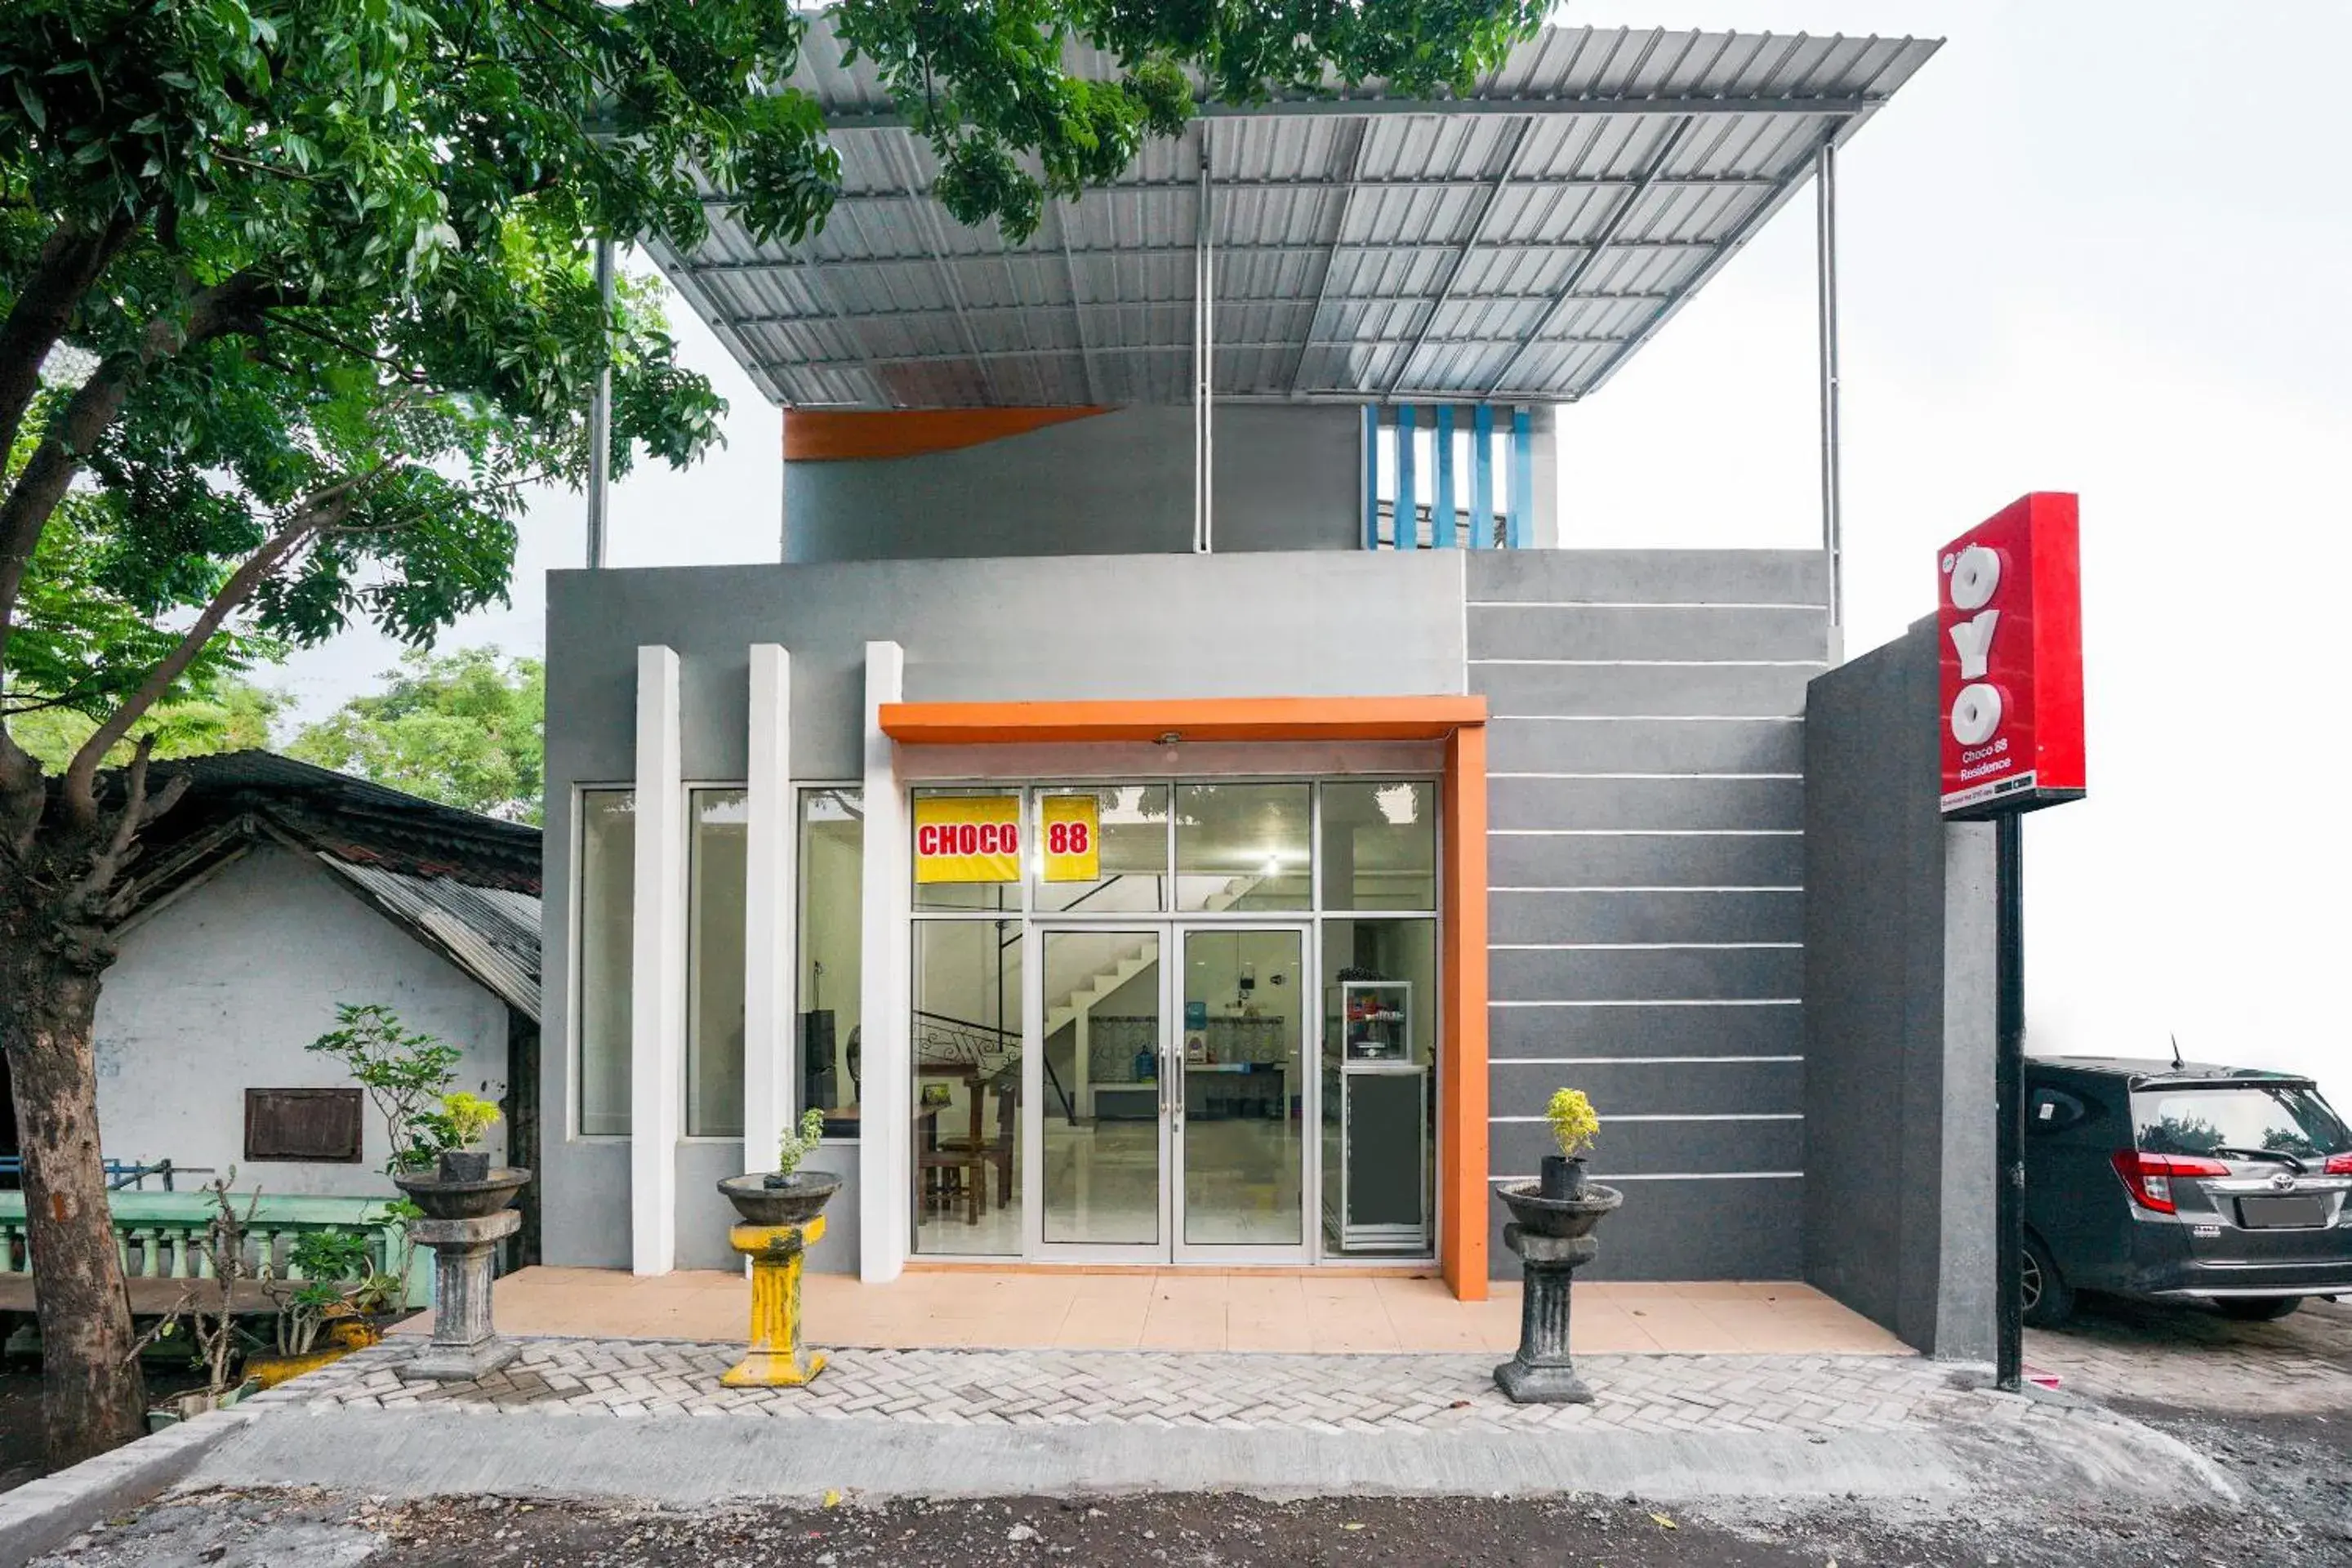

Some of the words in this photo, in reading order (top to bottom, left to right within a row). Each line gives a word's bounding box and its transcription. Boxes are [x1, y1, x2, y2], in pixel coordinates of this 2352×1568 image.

[1949, 546, 2002, 746] OYO
[1962, 746, 1993, 764] Choco
[1993, 737, 2008, 753] 88
[1960, 757, 2012, 782] Residence
[919, 823, 1018, 855] CHOCO
[1049, 822, 1089, 854] 88
